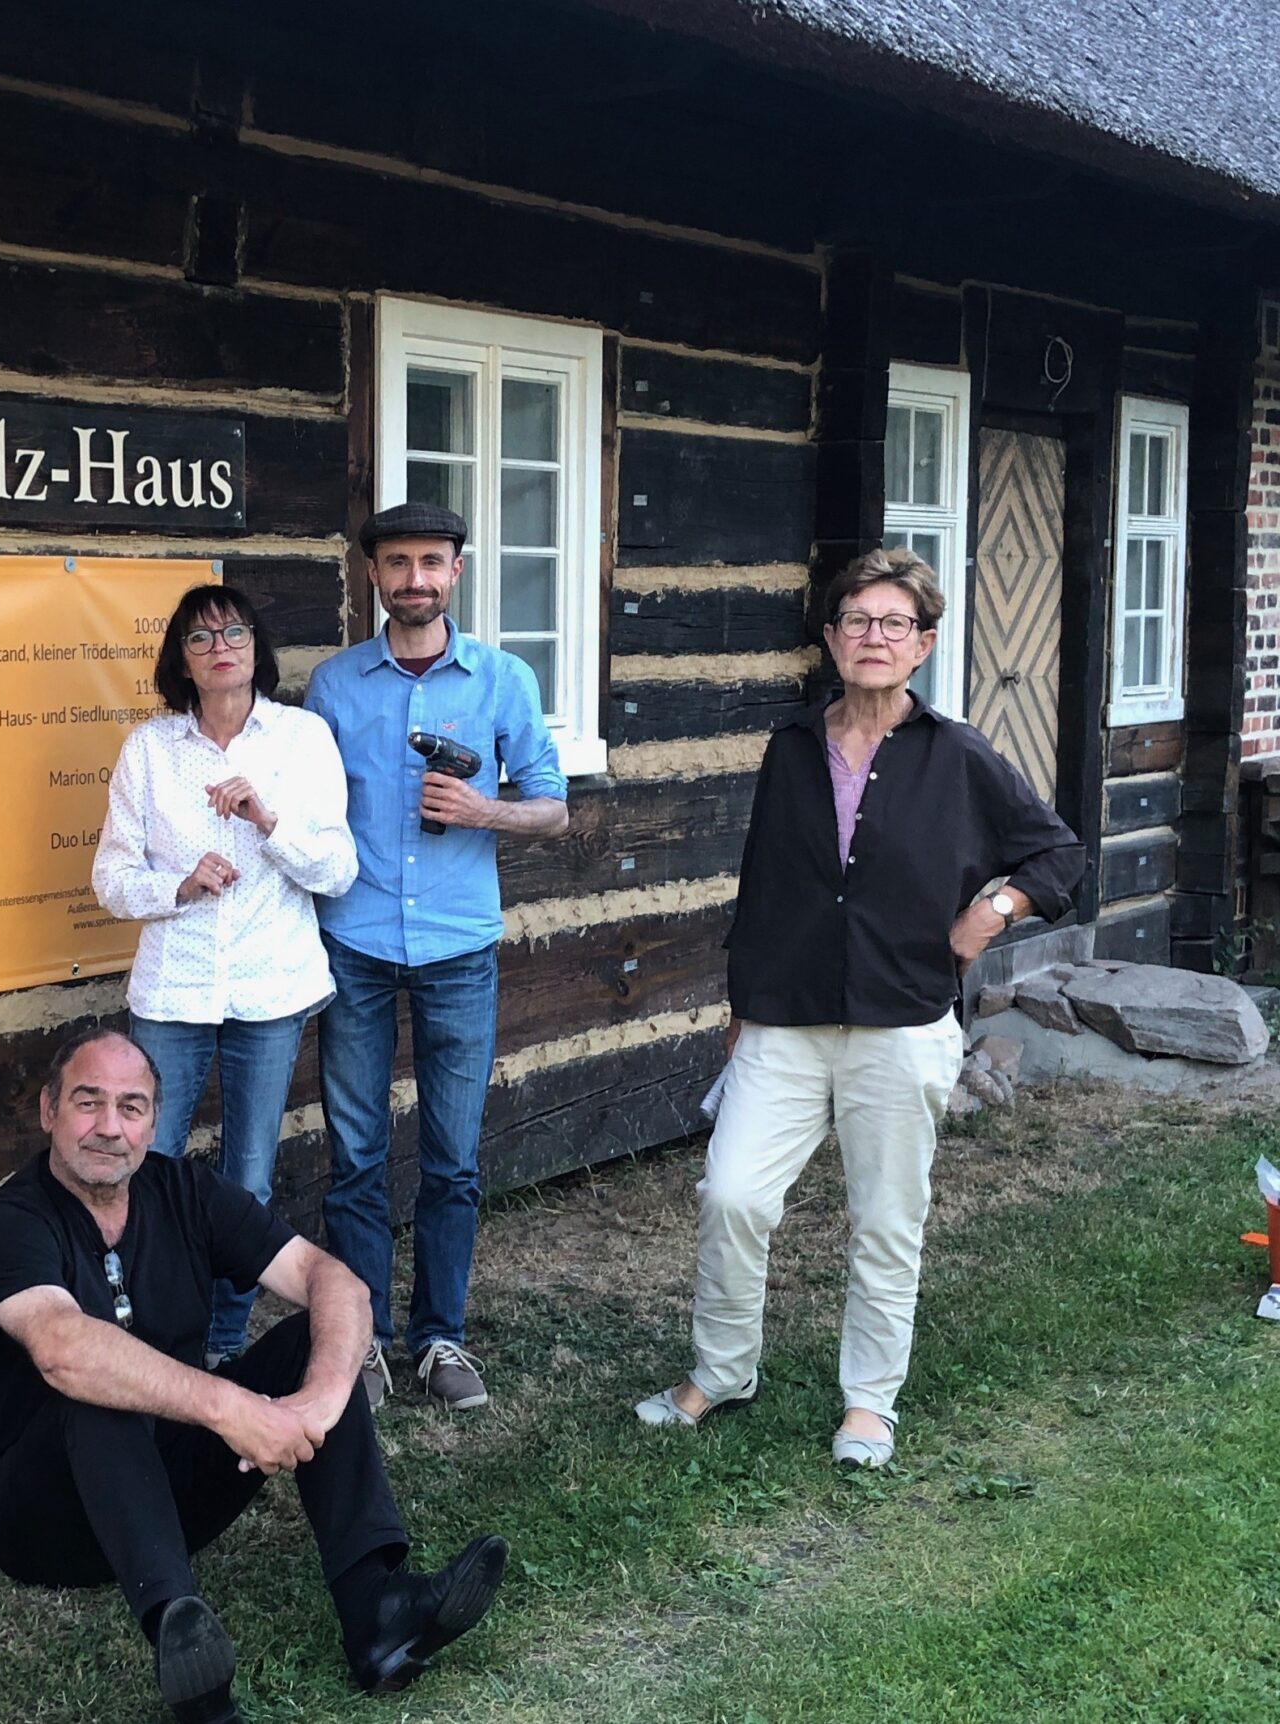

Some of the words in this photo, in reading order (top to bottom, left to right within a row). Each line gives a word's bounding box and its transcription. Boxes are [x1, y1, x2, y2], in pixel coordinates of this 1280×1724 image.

[33, 643, 77, 662] kleiner
[79, 641, 156, 661] Trödelmarkt
[41, 706, 67, 726] und
[49, 768, 95, 788] Marion
[98, 766, 113, 787] Q
[50, 832, 79, 850] Duo
